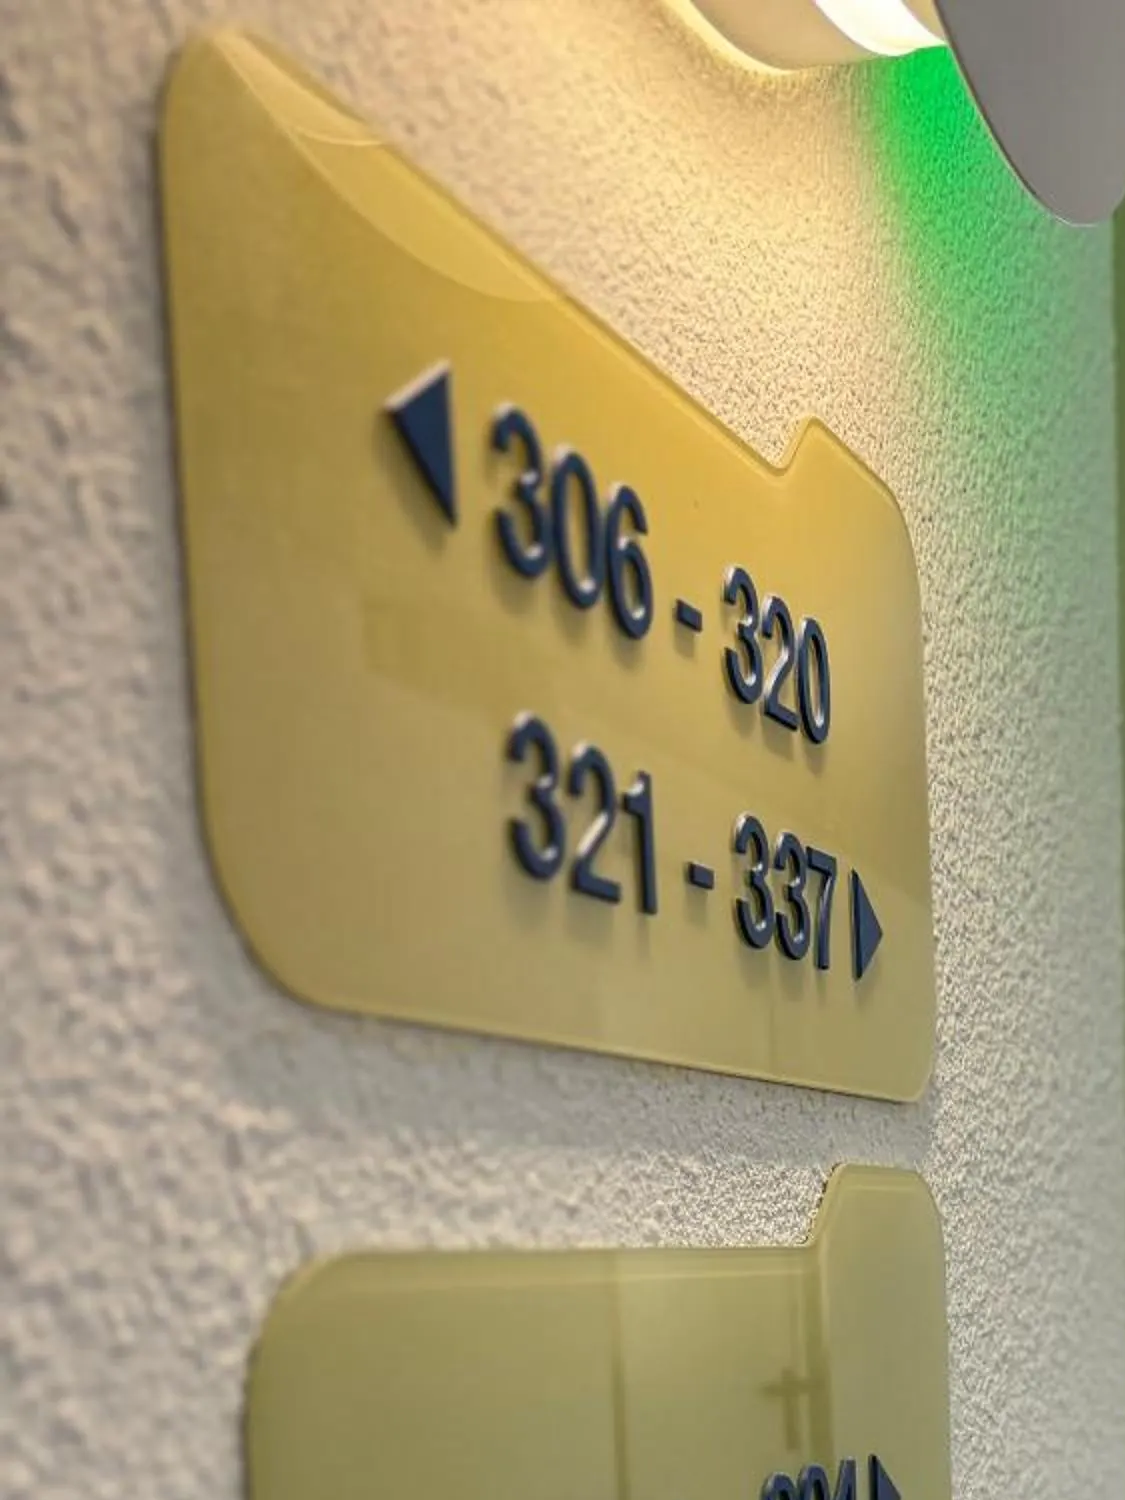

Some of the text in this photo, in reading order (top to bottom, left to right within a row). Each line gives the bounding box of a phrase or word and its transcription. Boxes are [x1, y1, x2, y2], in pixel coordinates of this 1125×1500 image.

[490, 401, 831, 745] 306 - 320
[505, 710, 837, 970] 321 - 337
